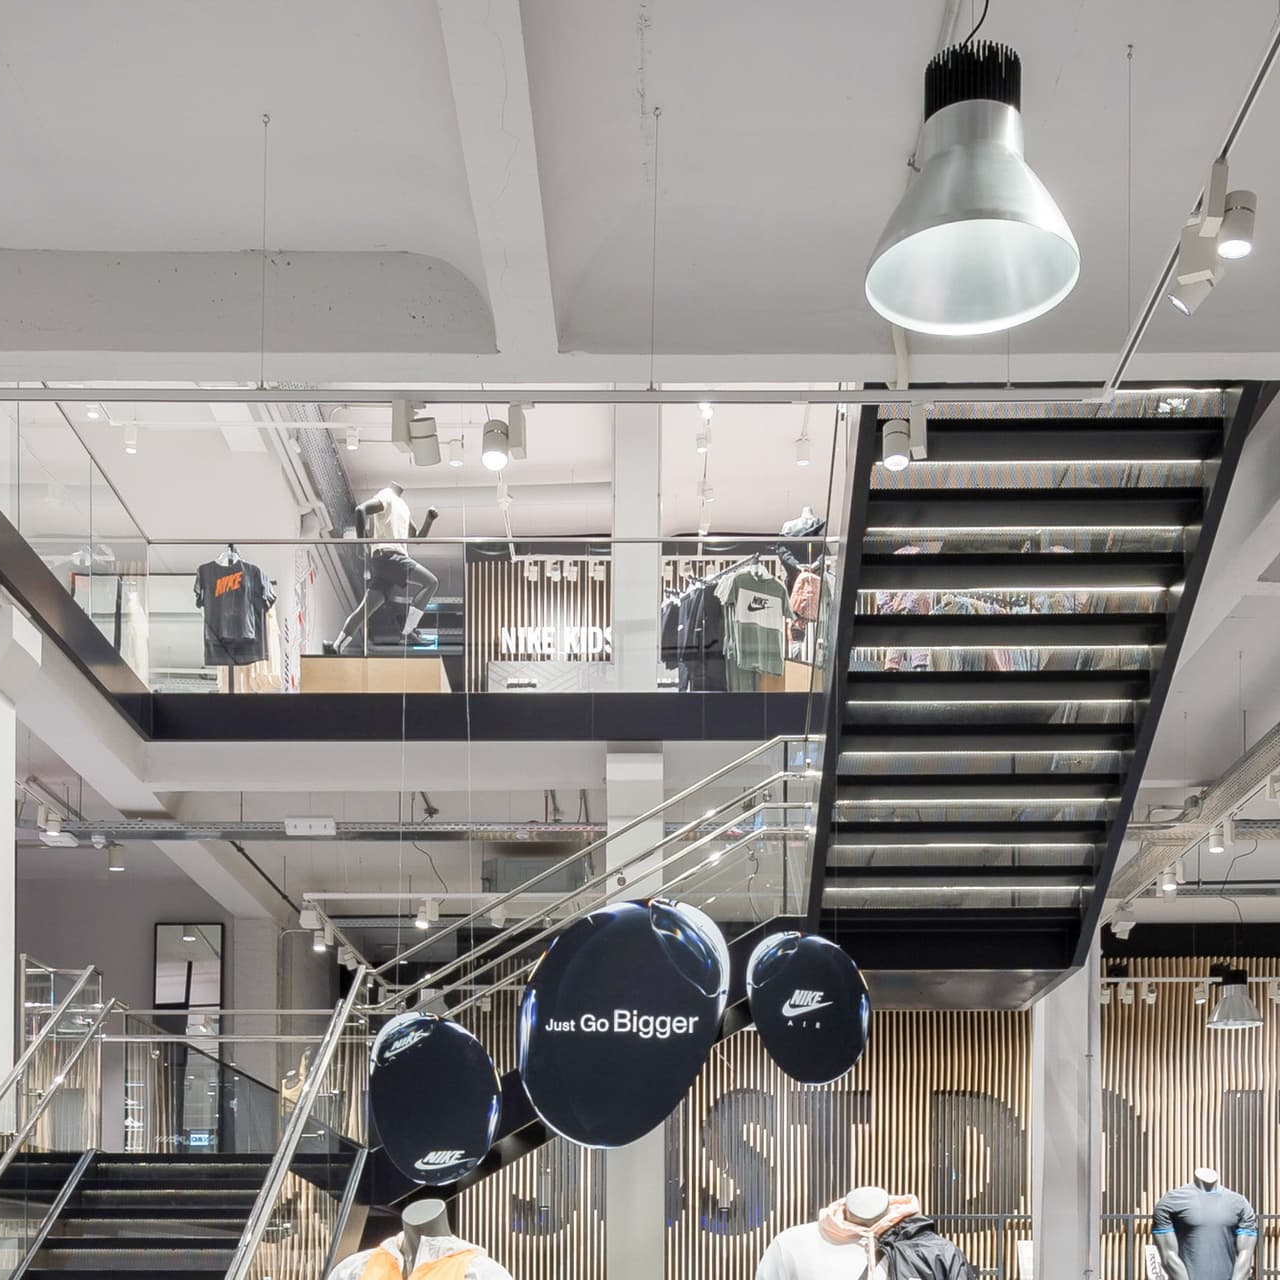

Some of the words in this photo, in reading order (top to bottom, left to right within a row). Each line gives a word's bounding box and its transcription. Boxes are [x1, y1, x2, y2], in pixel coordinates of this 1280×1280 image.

[215, 571, 244, 597] NIKE
[752, 596, 768, 607] NIKE
[502, 626, 554, 654] NIKE
[790, 990, 824, 1006] NIKE
[545, 1018, 575, 1032] Just
[580, 1014, 609, 1032] Go
[613, 1009, 699, 1039] Bigger
[423, 1151, 465, 1164] NIKE
